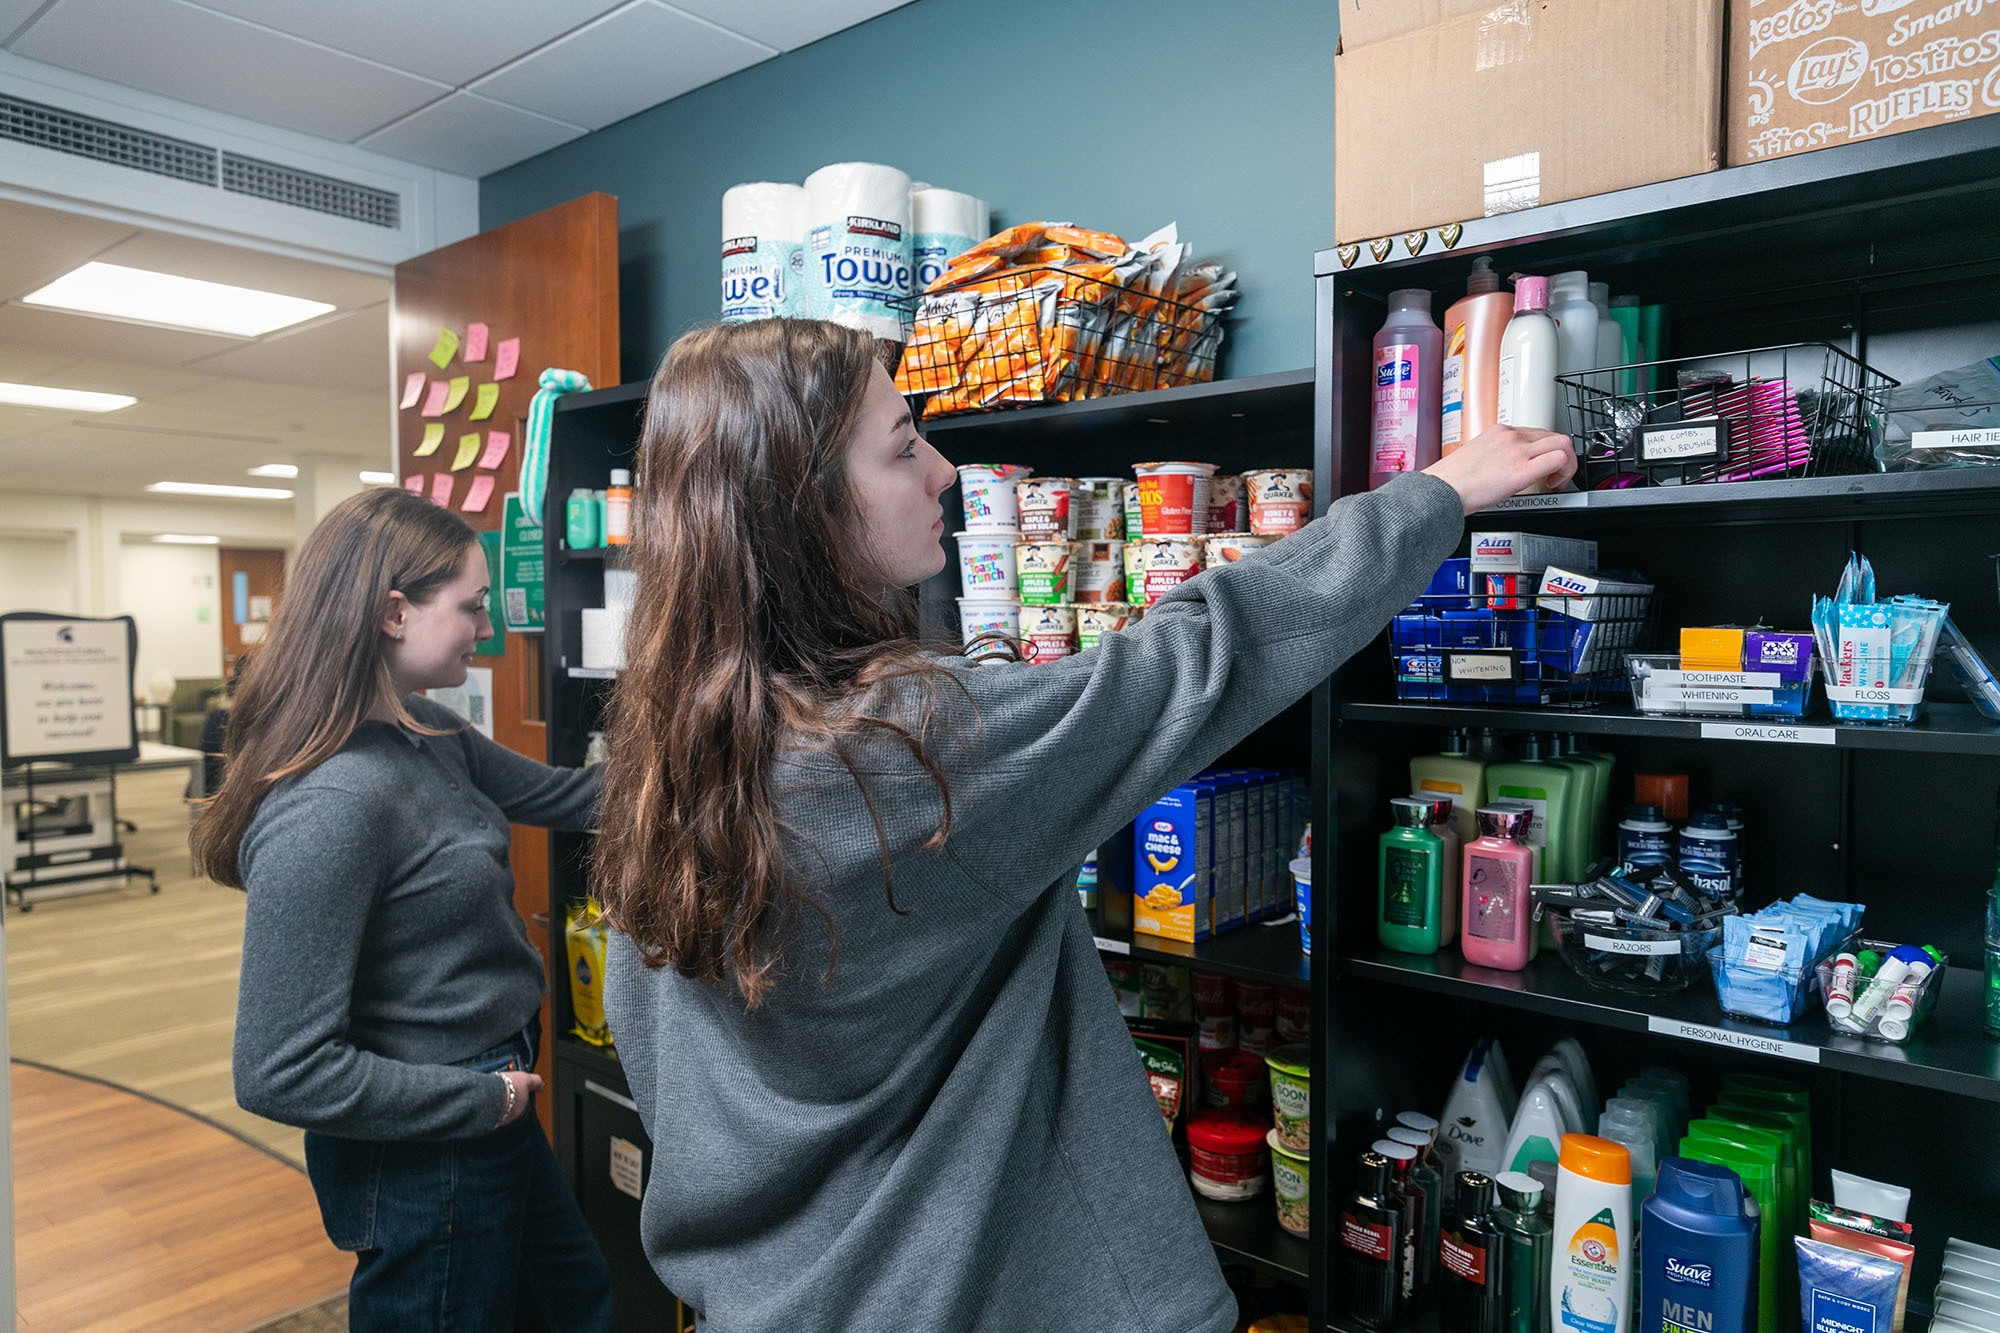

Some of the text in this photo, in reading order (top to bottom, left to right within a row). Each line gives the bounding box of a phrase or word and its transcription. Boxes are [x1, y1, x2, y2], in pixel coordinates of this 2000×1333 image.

[1794, 48, 1863, 90] Lay's
[1849, 80, 1973, 138] RUFFLES
[848, 216, 900, 234] KIRKLAND
[845, 246, 900, 261] PREMIUM
[1647, 435, 1666, 446] HAIR
[1951, 432, 1982, 444] HAIR
[1649, 438, 1716, 457] PICKS, BRUSHES
[1264, 491, 1294, 500] QUAKER
[1496, 496, 1559, 508] CONDITIONER
[1477, 537, 1513, 547] Aim
[1151, 559, 1179, 568] QUAKER
[967, 568, 1005, 585] Crunch
[1549, 576, 1587, 593] Aim
[1451, 657, 1467, 665] NON
[1458, 665, 1506, 675] WHITENING
[1682, 672, 1747, 684] TOOTHPASTE
[1682, 690, 1739, 701] WHITENING
[1855, 690, 1890, 700] FLOSS
[1735, 727, 1800, 740] ORAL CARE
[1613, 942, 1652, 953] RAZORS
[1680, 1025, 1784, 1054] PERSONAL HYGEINE
[1277, 1084, 1307, 1101] SOON
[1448, 1123, 1485, 1147] Dove
[1571, 1255, 1617, 1274] Essentials
[1665, 1257, 1712, 1281] Suave
[1591, 1275, 1611, 1286] WASH
[1667, 1270, 1710, 1287] PROFESSIONALS
[1663, 1298, 1713, 1331] MEN
[1852, 1304, 1871, 1313] WORKS
[1570, 1317, 1604, 1332] Clear Water
[1821, 1317, 1865, 1333] MIDNIGHT
